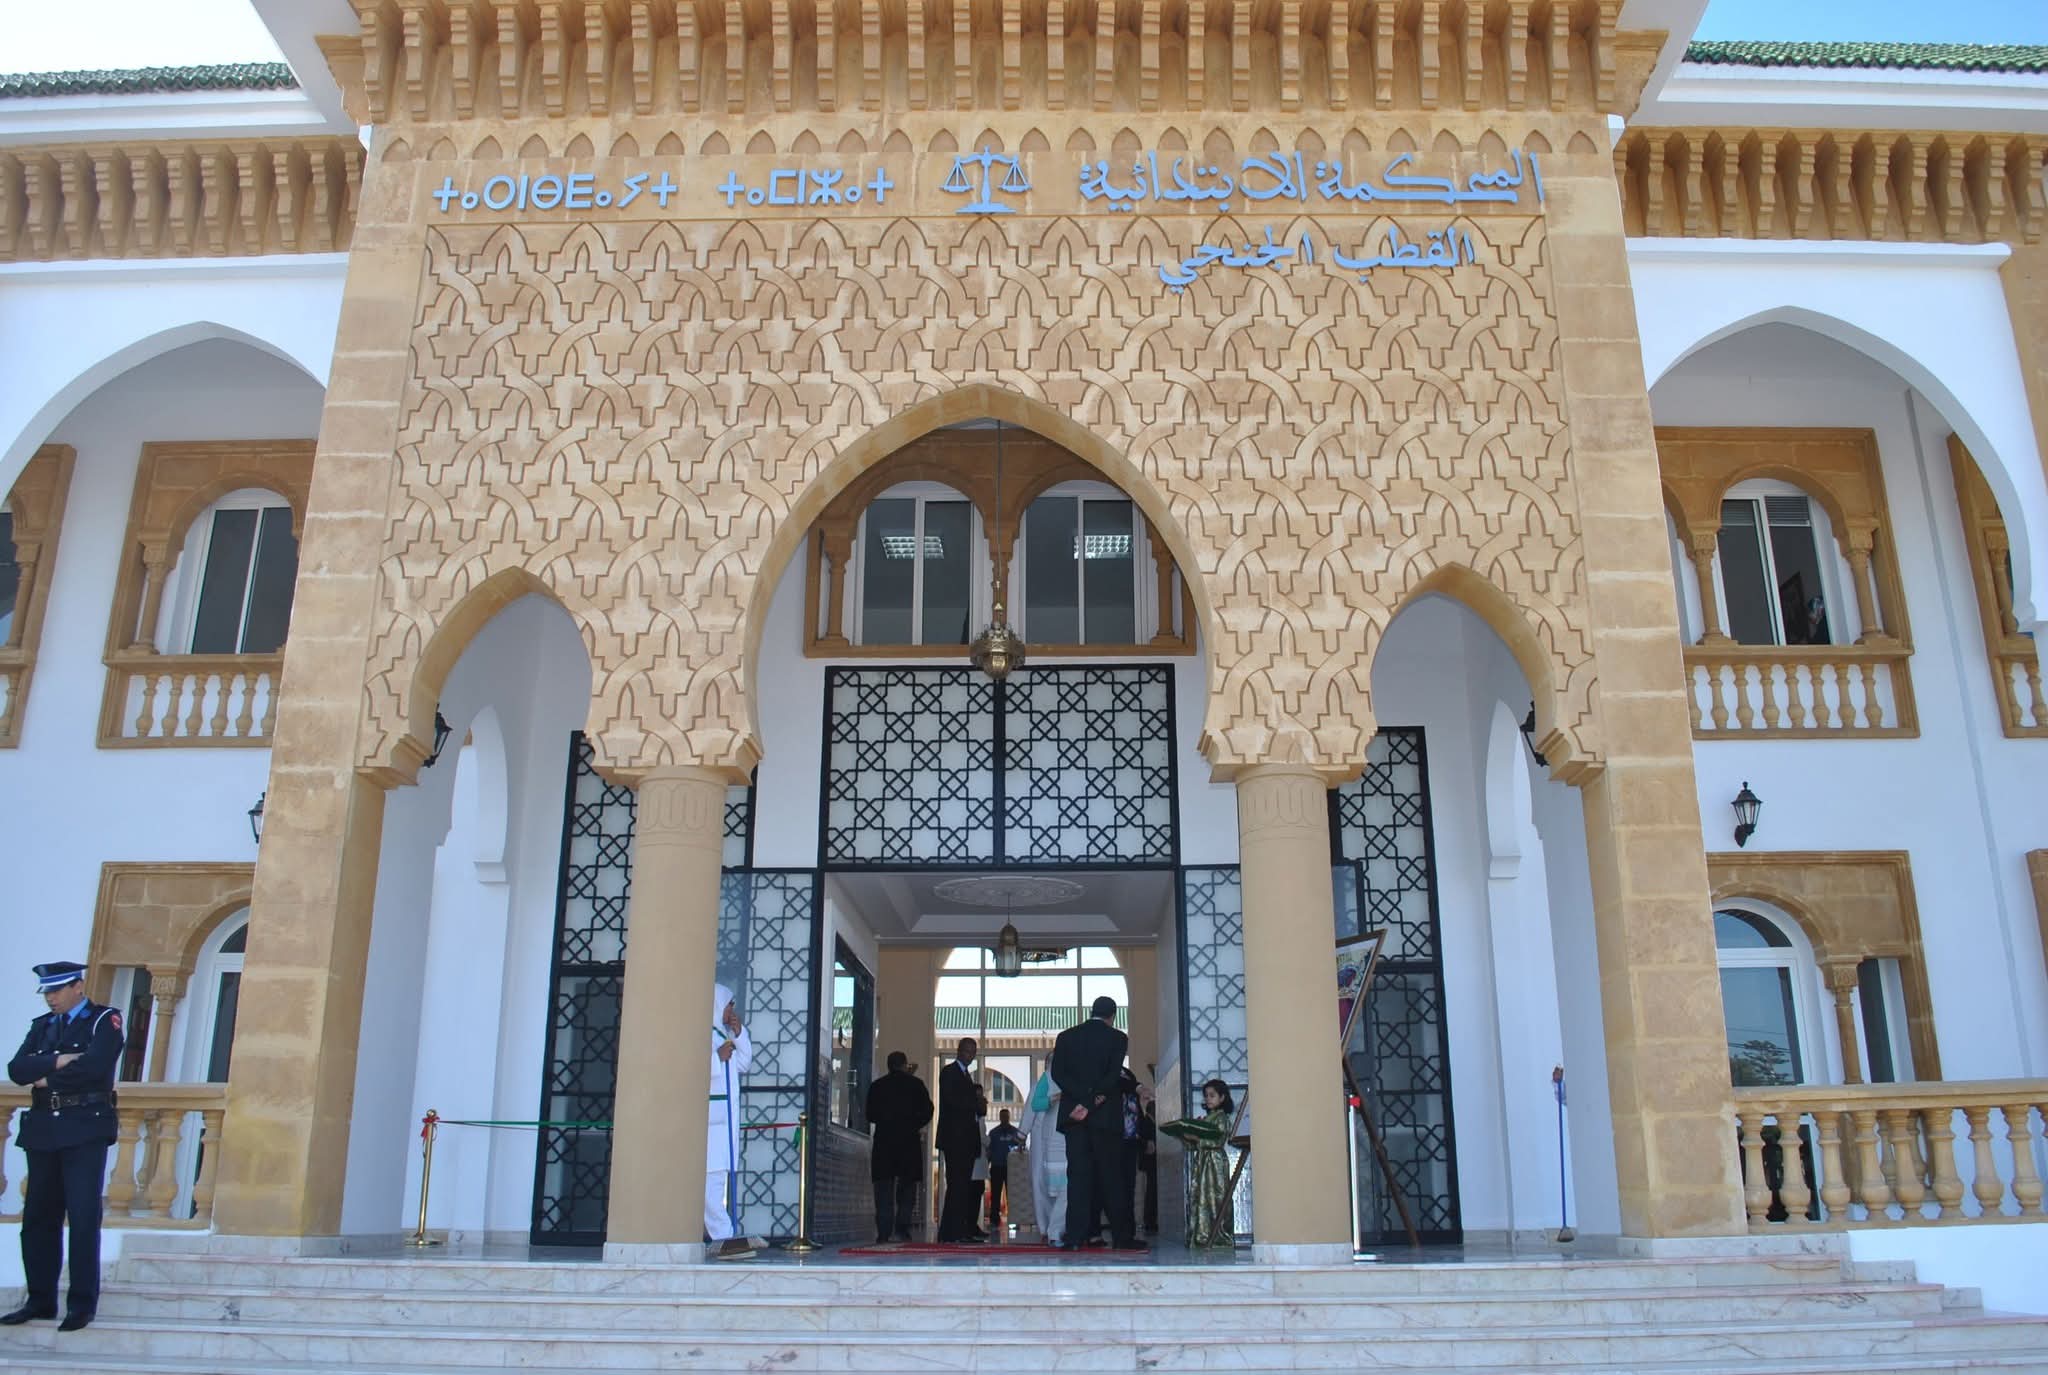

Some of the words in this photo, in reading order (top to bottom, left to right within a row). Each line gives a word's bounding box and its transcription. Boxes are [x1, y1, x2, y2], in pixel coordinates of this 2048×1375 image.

[1079, 149, 1308, 212] الابتدائية
[1315, 148, 1546, 205] المحكمة
[1158, 225, 1313, 295] الجنحي
[1333, 226, 1476, 283] القطب
